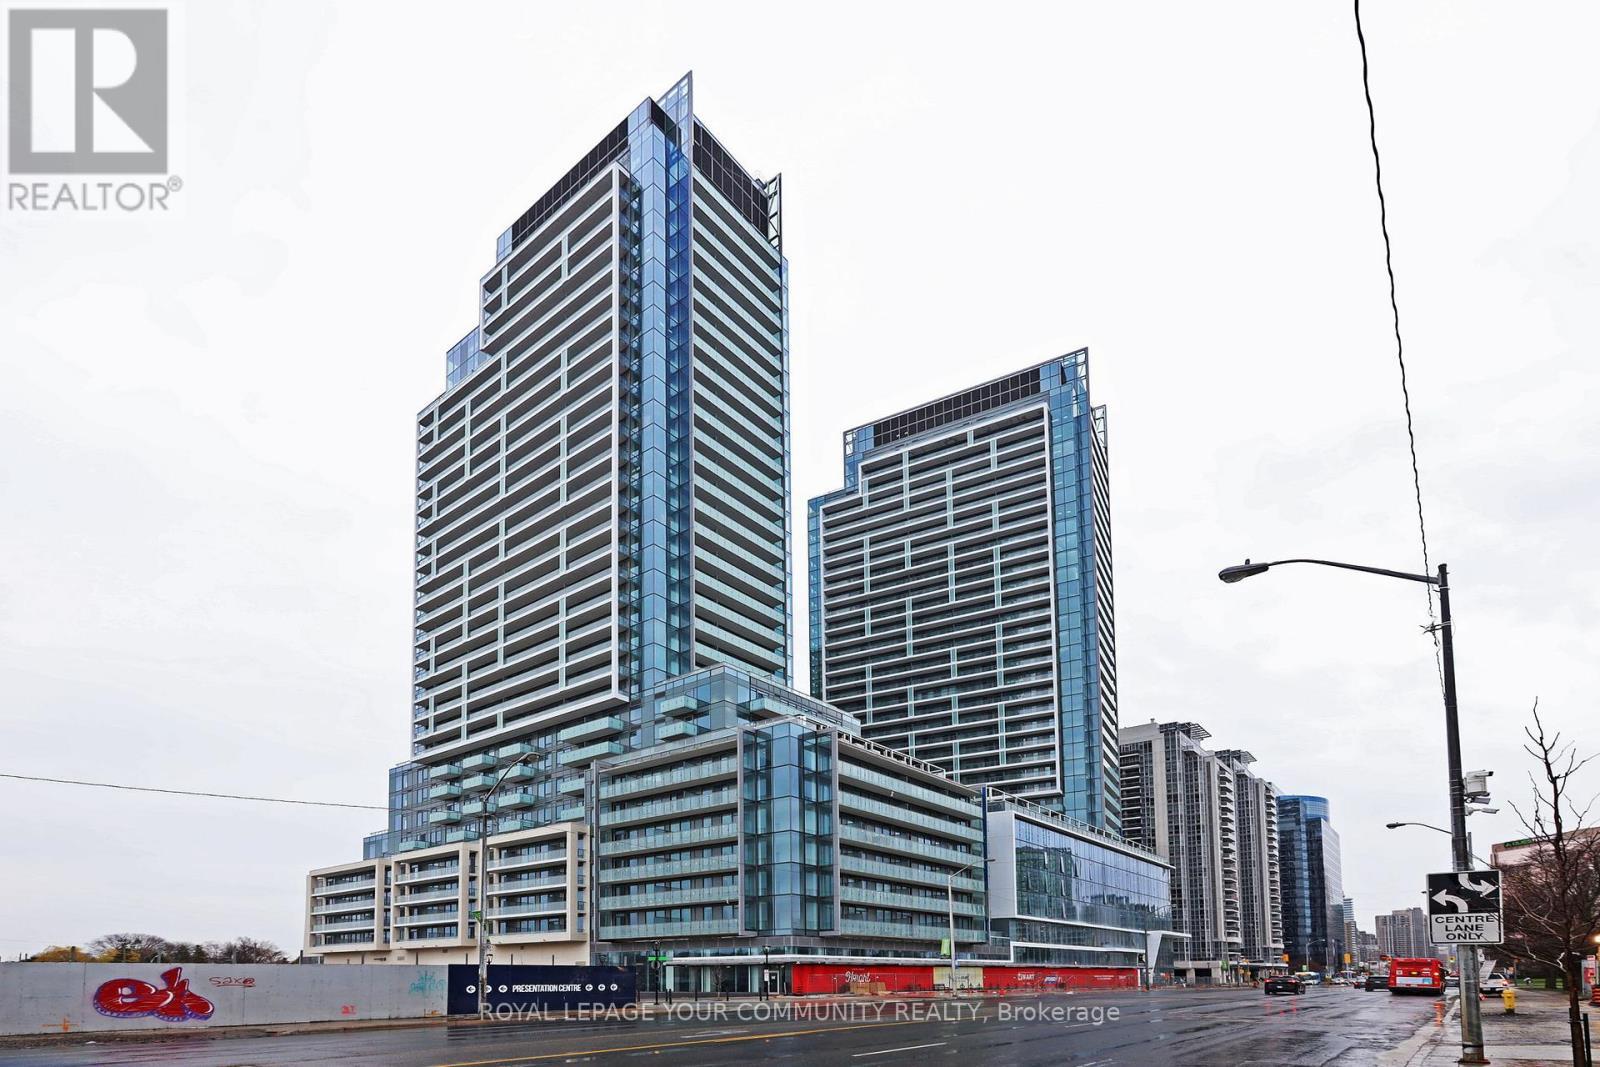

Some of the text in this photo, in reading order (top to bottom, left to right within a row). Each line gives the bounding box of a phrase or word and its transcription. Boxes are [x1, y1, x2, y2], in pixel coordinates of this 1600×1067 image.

[1434, 915, 1495, 924] CENTRE
[1445, 924, 1485, 932] LANE
[1446, 932, 1484, 940] ONLY
[512, 983, 582, 993] PRESENTATION CENTRE
